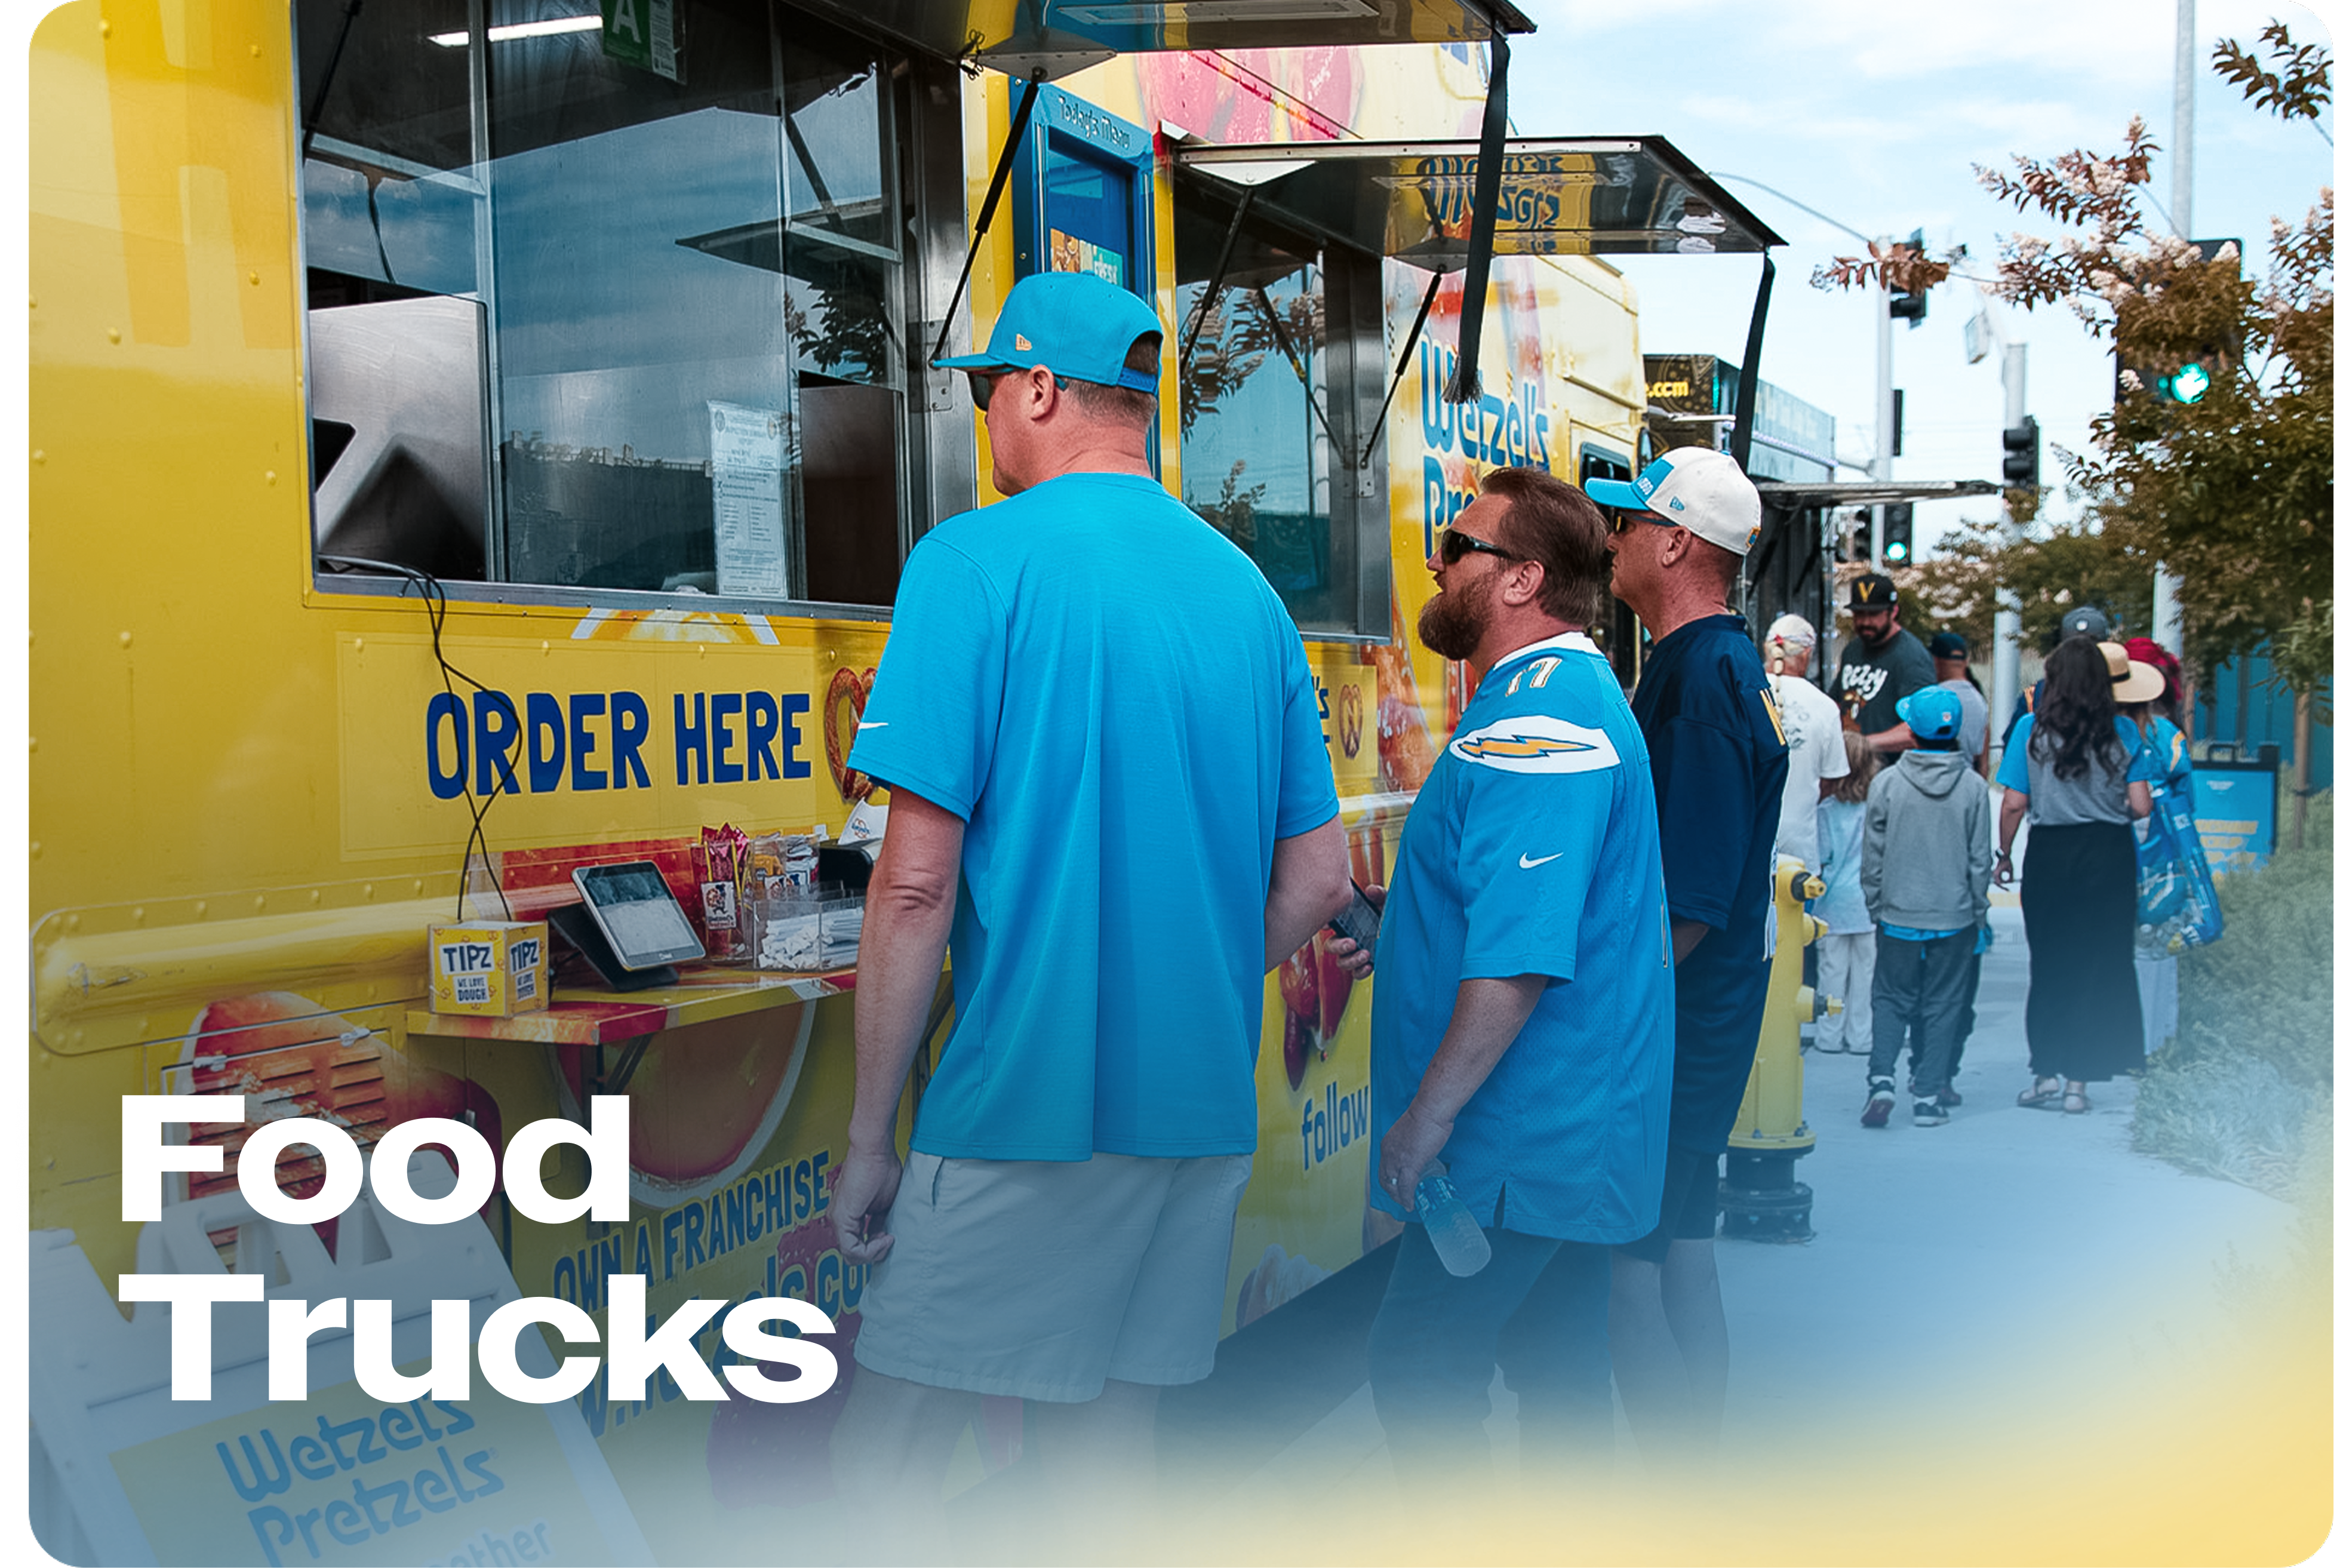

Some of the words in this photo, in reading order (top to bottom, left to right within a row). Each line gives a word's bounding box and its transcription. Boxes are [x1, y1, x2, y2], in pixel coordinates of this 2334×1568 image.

[612, 0, 642, 44] A
[1858, 582, 1875, 602] V
[427, 690, 651, 800] ORDER
[675, 691, 811, 786] HERE
[443, 945, 491, 972] TIPZ
[511, 940, 538, 972] TIPZ
[1302, 1081, 1369, 1171] follow
[663, 1150, 831, 1282] FRANCHISE
[247, 1446, 505, 1568] Pretzels
